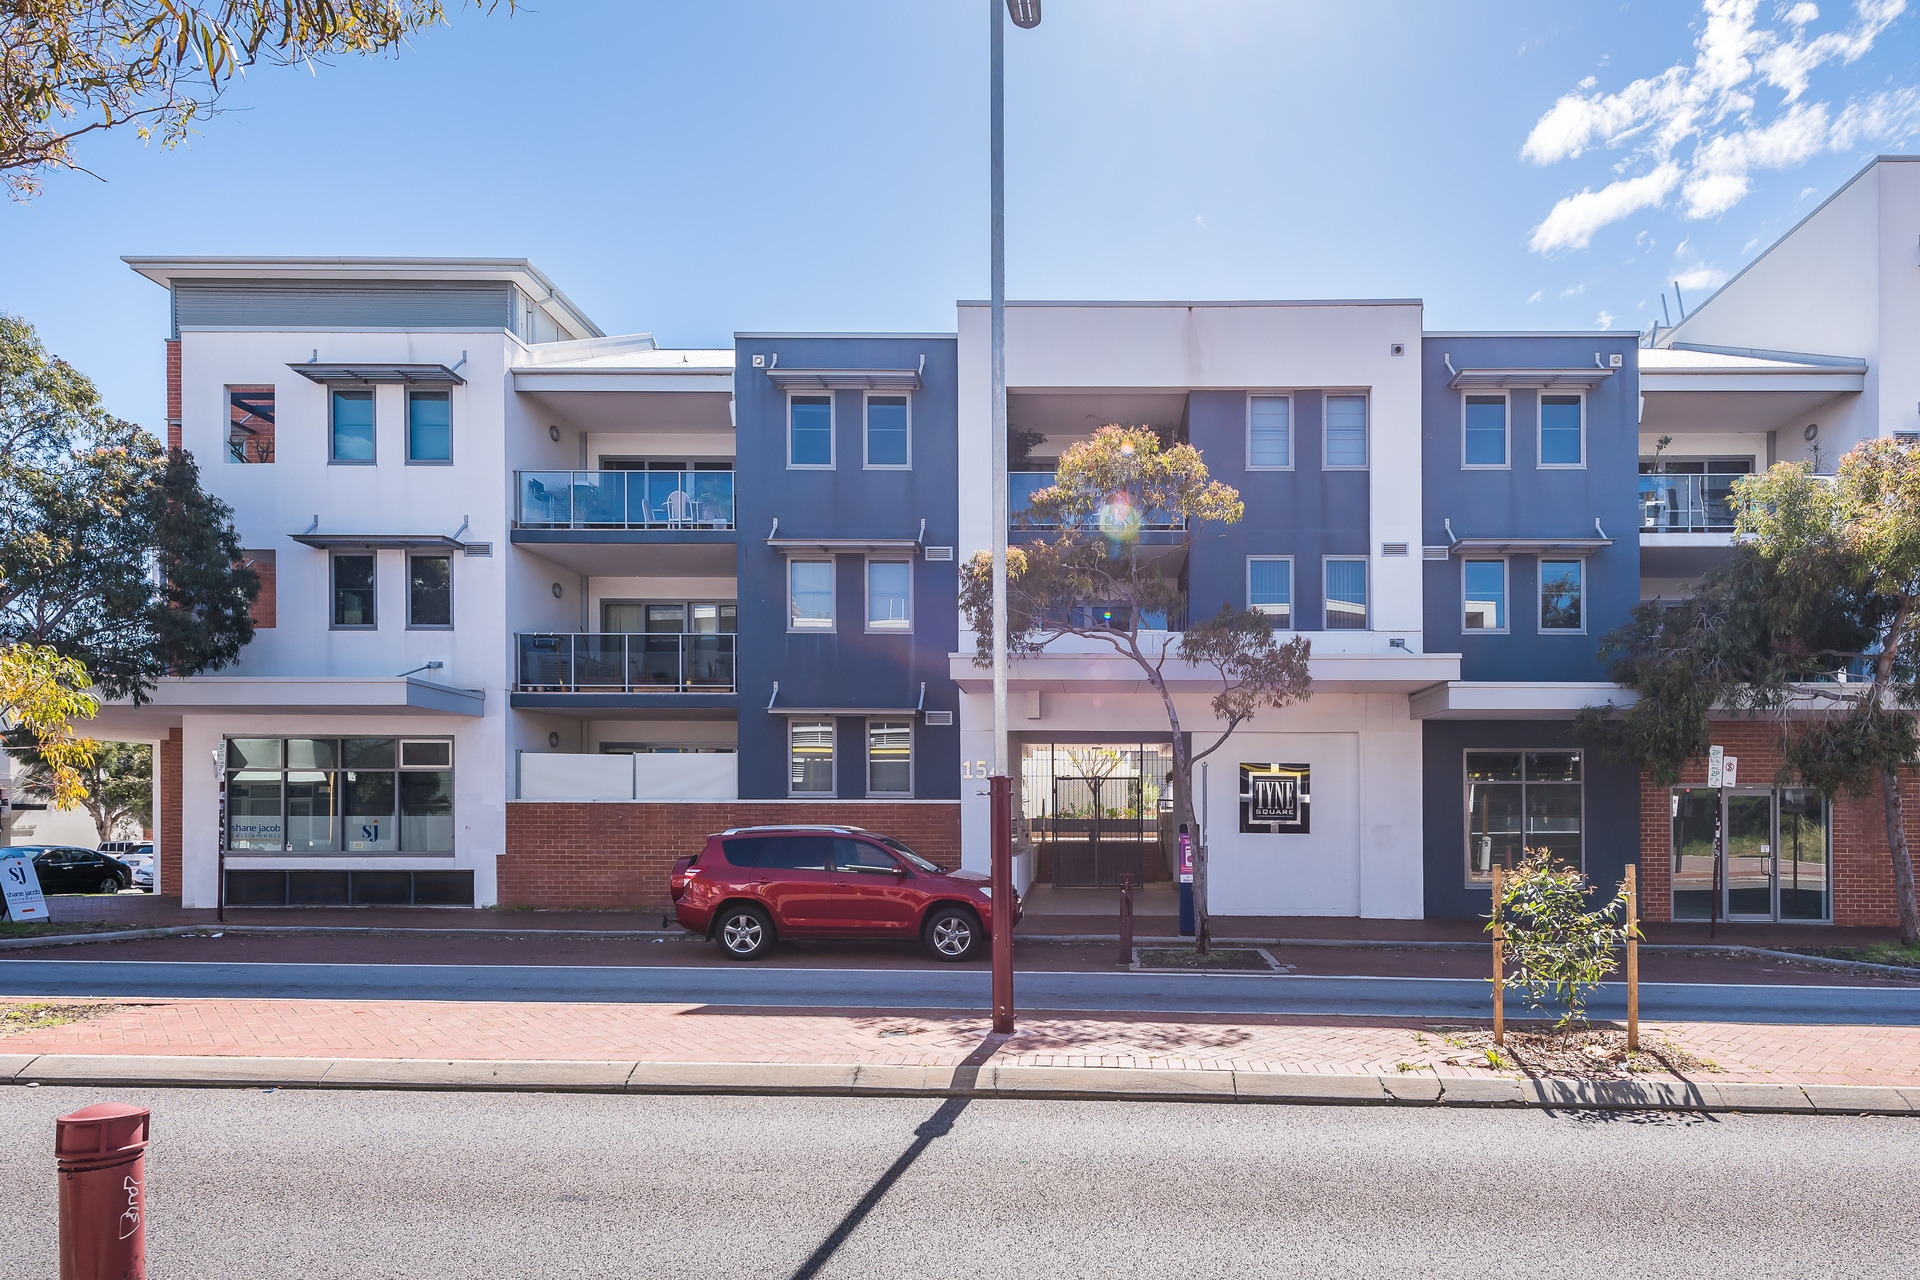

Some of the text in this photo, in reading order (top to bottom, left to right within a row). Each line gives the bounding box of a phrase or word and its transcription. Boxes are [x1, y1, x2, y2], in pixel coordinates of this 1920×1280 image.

[1256, 782, 1293, 809] TYNE
[231, 824, 281, 834] shane jacob
[362, 819, 379, 842] sj
[8, 861, 27, 885] sj
[25, 889, 41, 897] jacob
